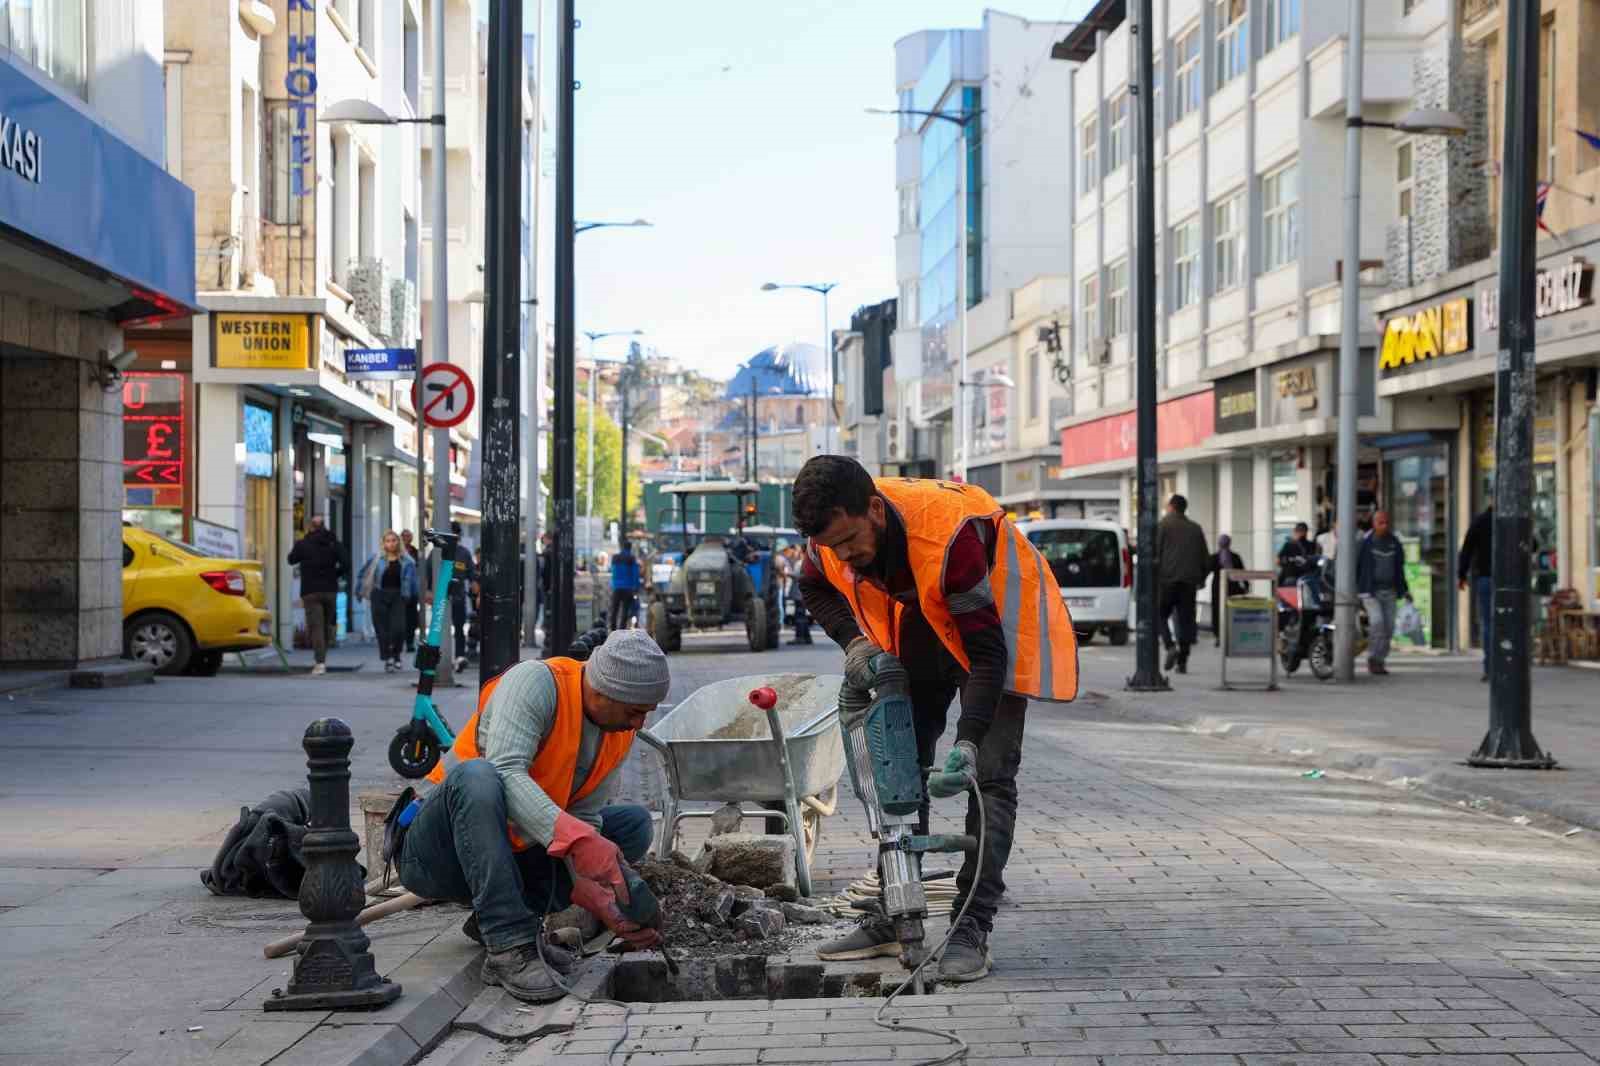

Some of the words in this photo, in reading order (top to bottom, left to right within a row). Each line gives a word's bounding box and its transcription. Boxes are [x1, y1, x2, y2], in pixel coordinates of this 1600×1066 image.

[286, 34, 318, 196] HOTEL
[221, 320, 291, 335] WESTERN
[243, 337, 291, 350] UNION
[347, 352, 389, 364] KANBER
